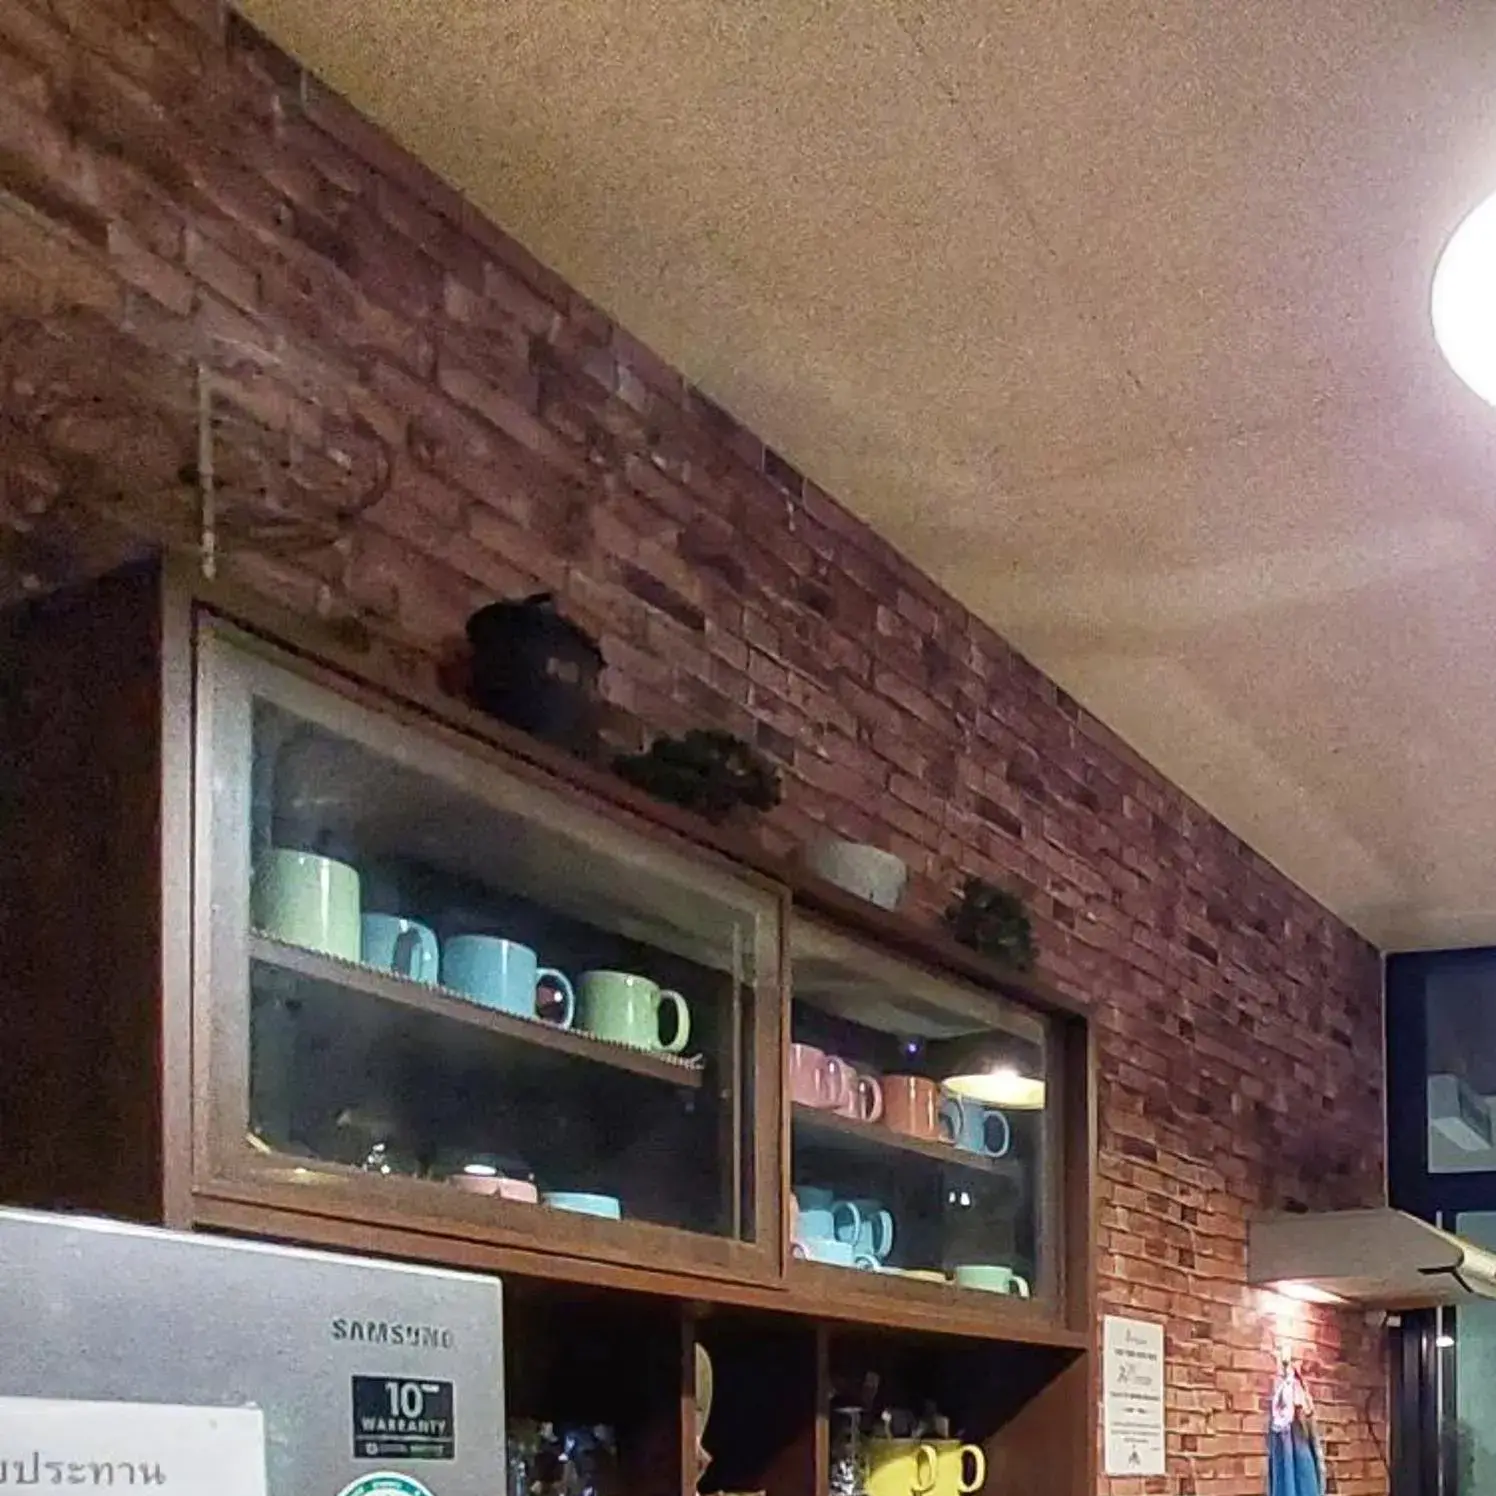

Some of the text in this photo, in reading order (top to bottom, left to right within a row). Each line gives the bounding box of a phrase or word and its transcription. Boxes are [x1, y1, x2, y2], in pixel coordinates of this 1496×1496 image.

[332, 1318, 454, 1349] SAMSUNG
[384, 1381, 424, 1419] 10
[360, 1416, 447, 1435] WARRANTY
